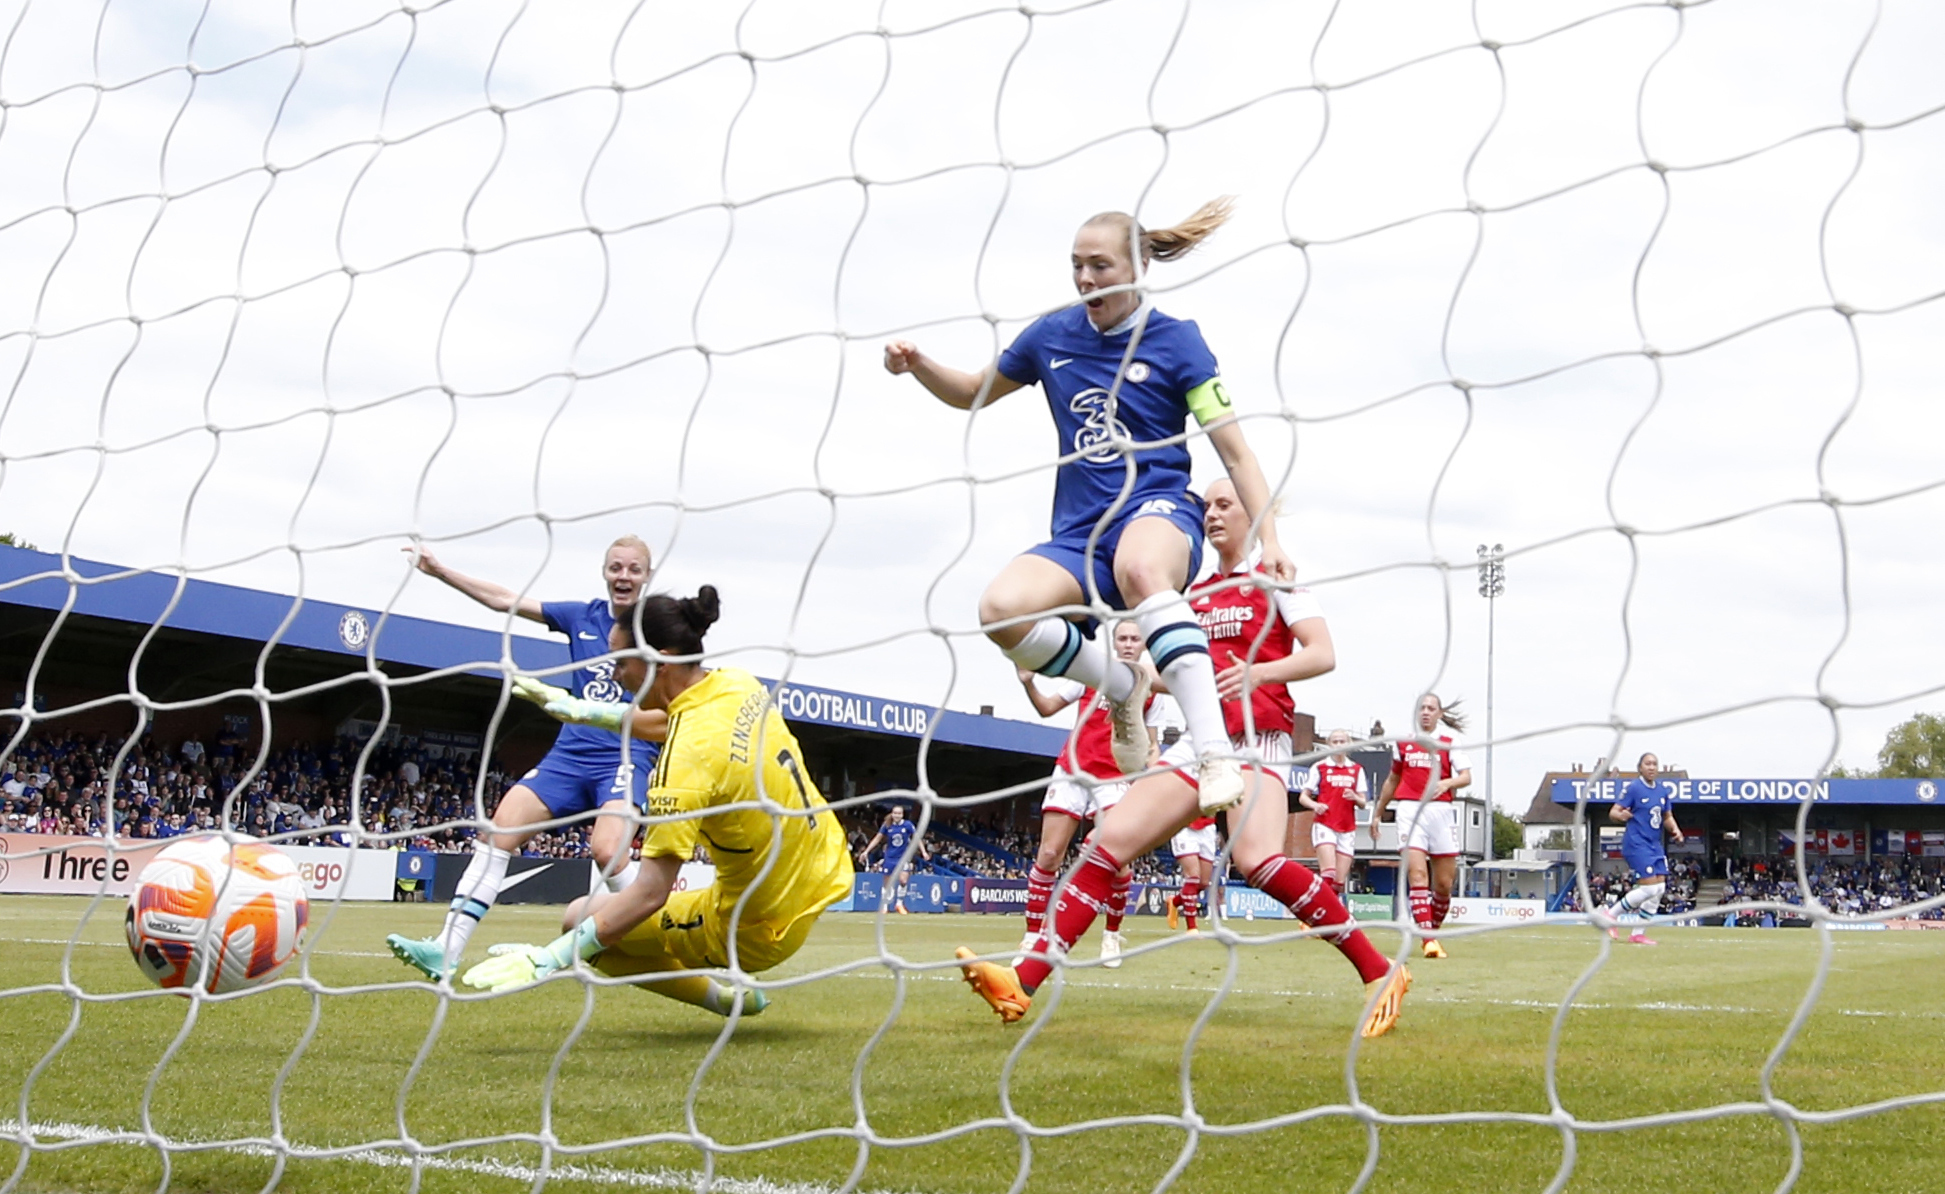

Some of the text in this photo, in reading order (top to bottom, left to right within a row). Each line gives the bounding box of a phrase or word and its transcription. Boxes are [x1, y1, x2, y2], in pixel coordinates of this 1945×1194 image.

[1212, 382, 1231, 407] C
[777, 687, 928, 735] FOOTBALL CLUB
[776, 749, 817, 831] 1
[1571, 781, 1616, 800] THE
[1698, 781, 1721, 795] OF
[1727, 781, 1829, 800] LONDON
[650, 796, 680, 807] VISIT
[39, 847, 130, 882] Three
[980, 889, 1030, 904] BARCLAYS WS
[1240, 893, 1279, 912] BARCLAYS
[1487, 904, 1535, 921] trivago
